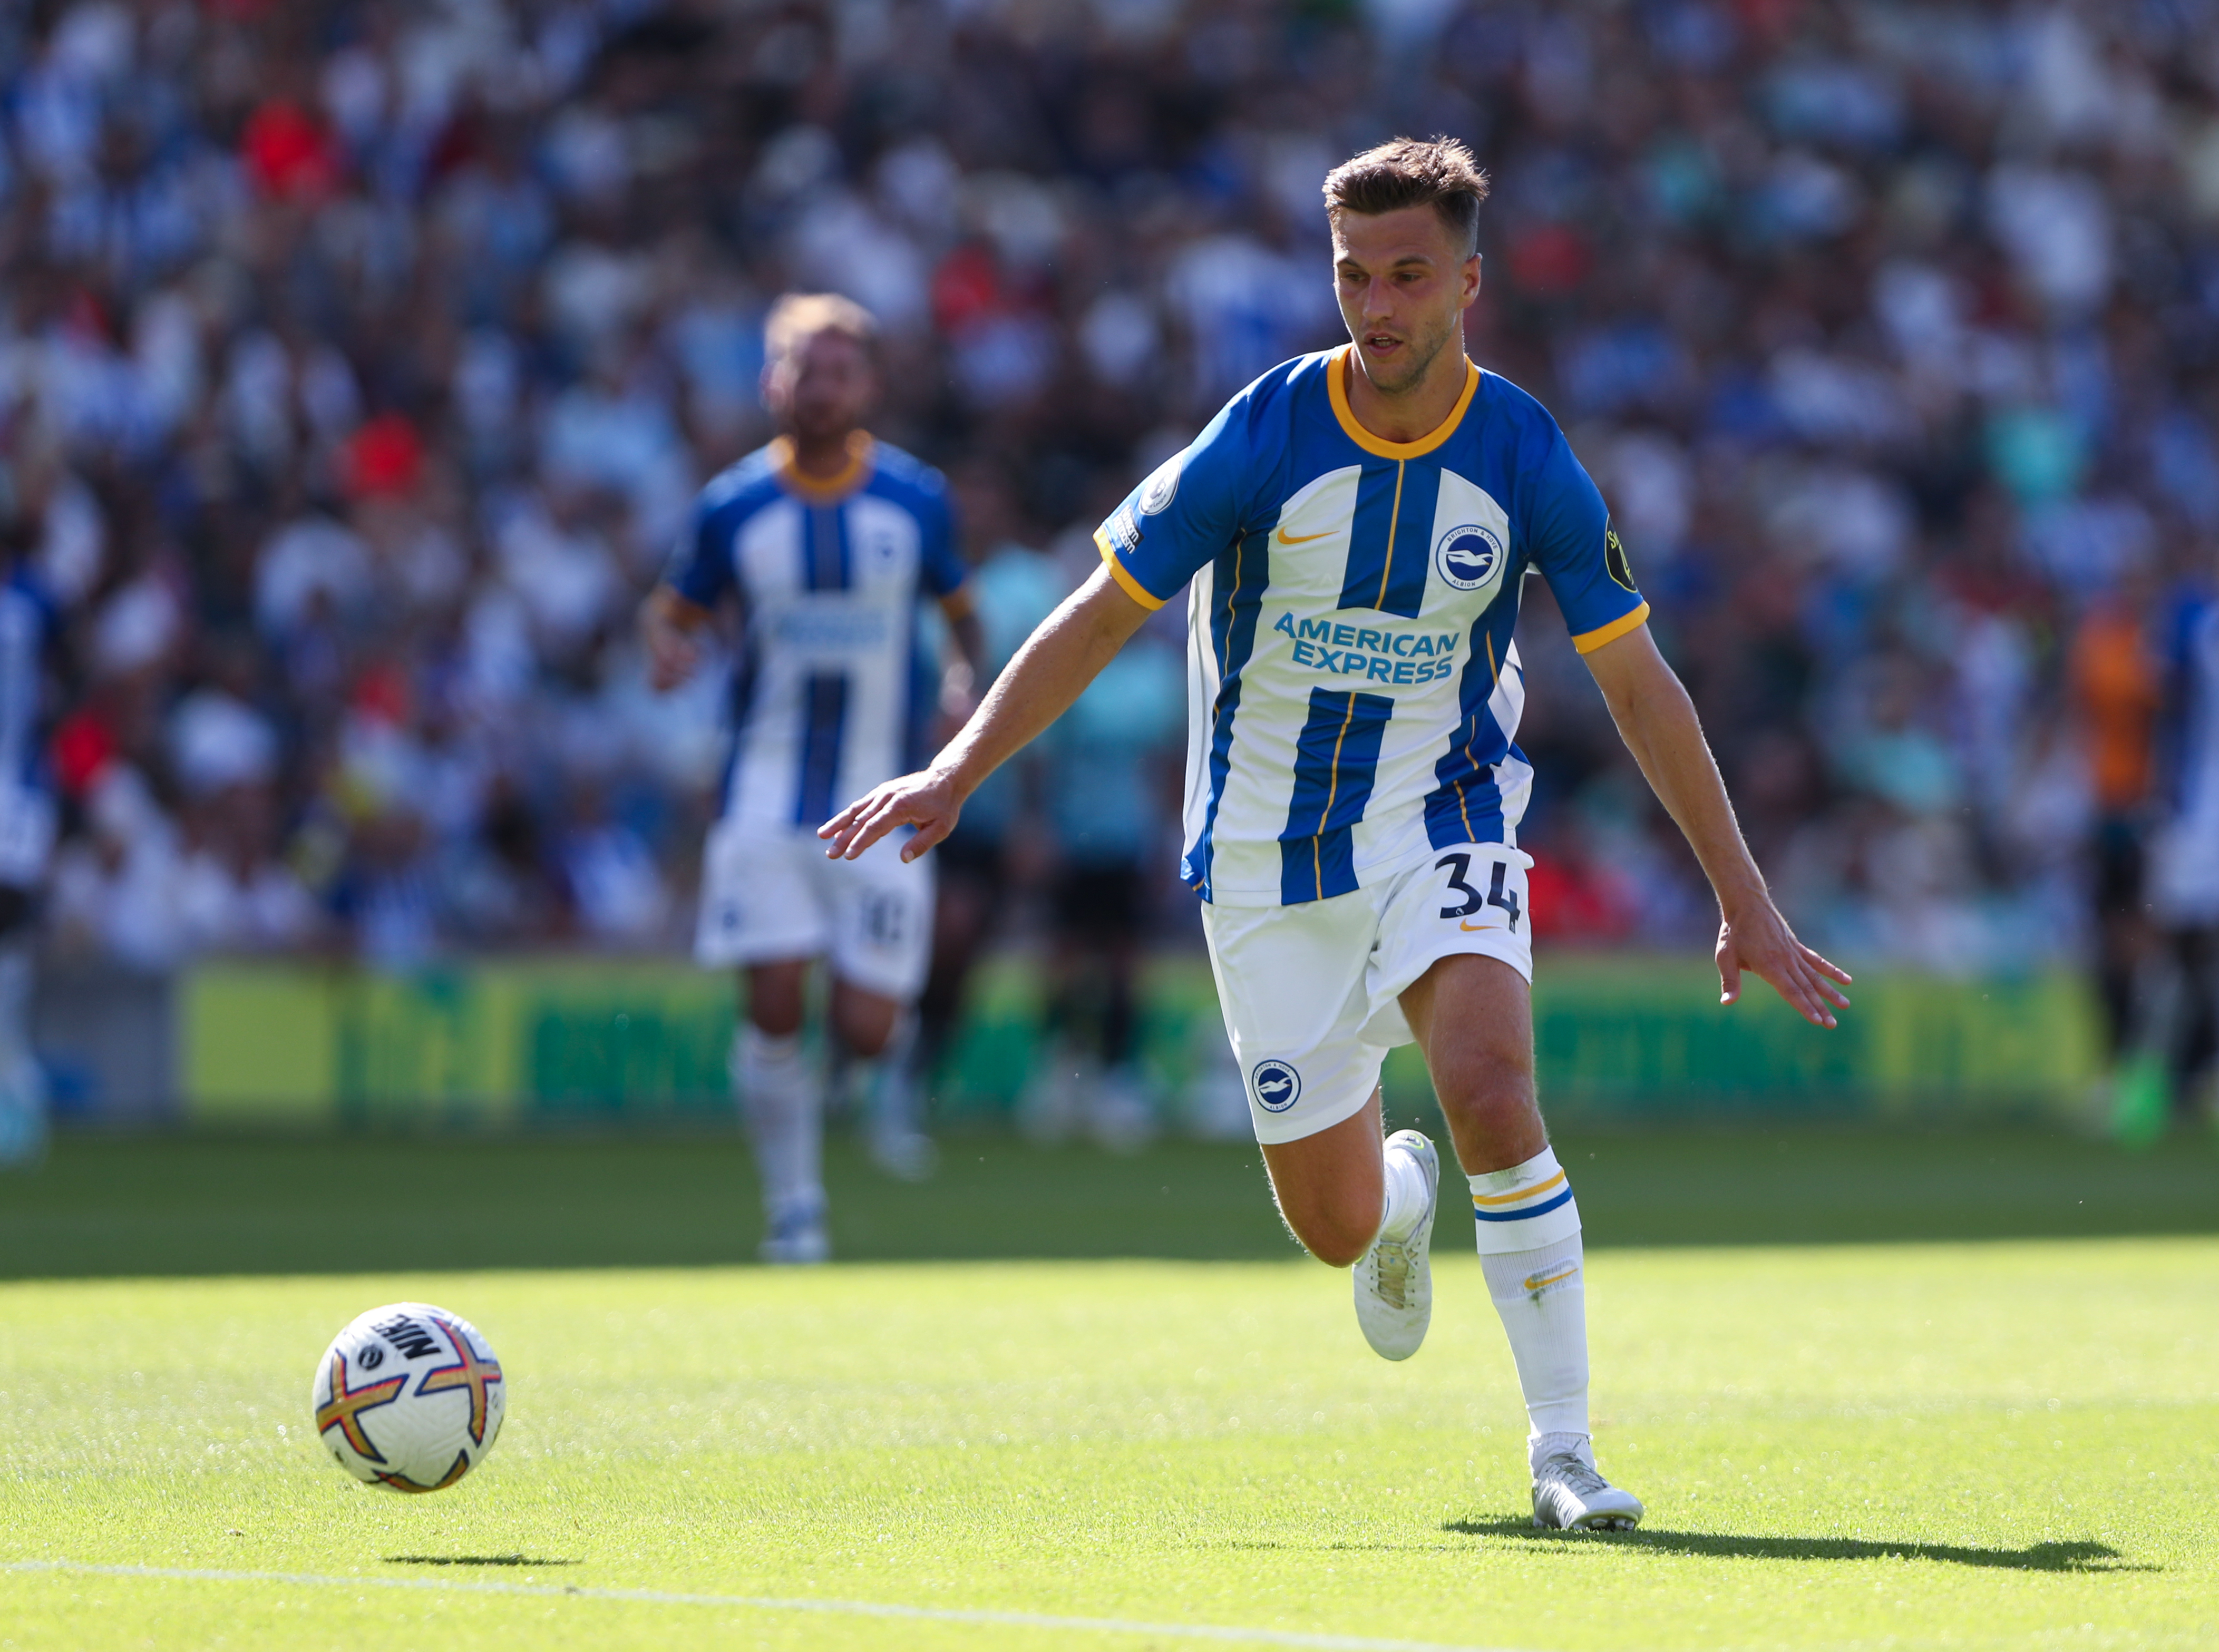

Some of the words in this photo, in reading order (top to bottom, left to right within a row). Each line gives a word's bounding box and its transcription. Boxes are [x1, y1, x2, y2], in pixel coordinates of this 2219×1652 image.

[1447, 527, 1478, 542] BRIGHTON
[1486, 534, 1498, 549] HOVE
[1273, 611, 1459, 658] AMERICAN
[1292, 639, 1453, 684] EXPRESS
[1435, 853, 1521, 934] 34
